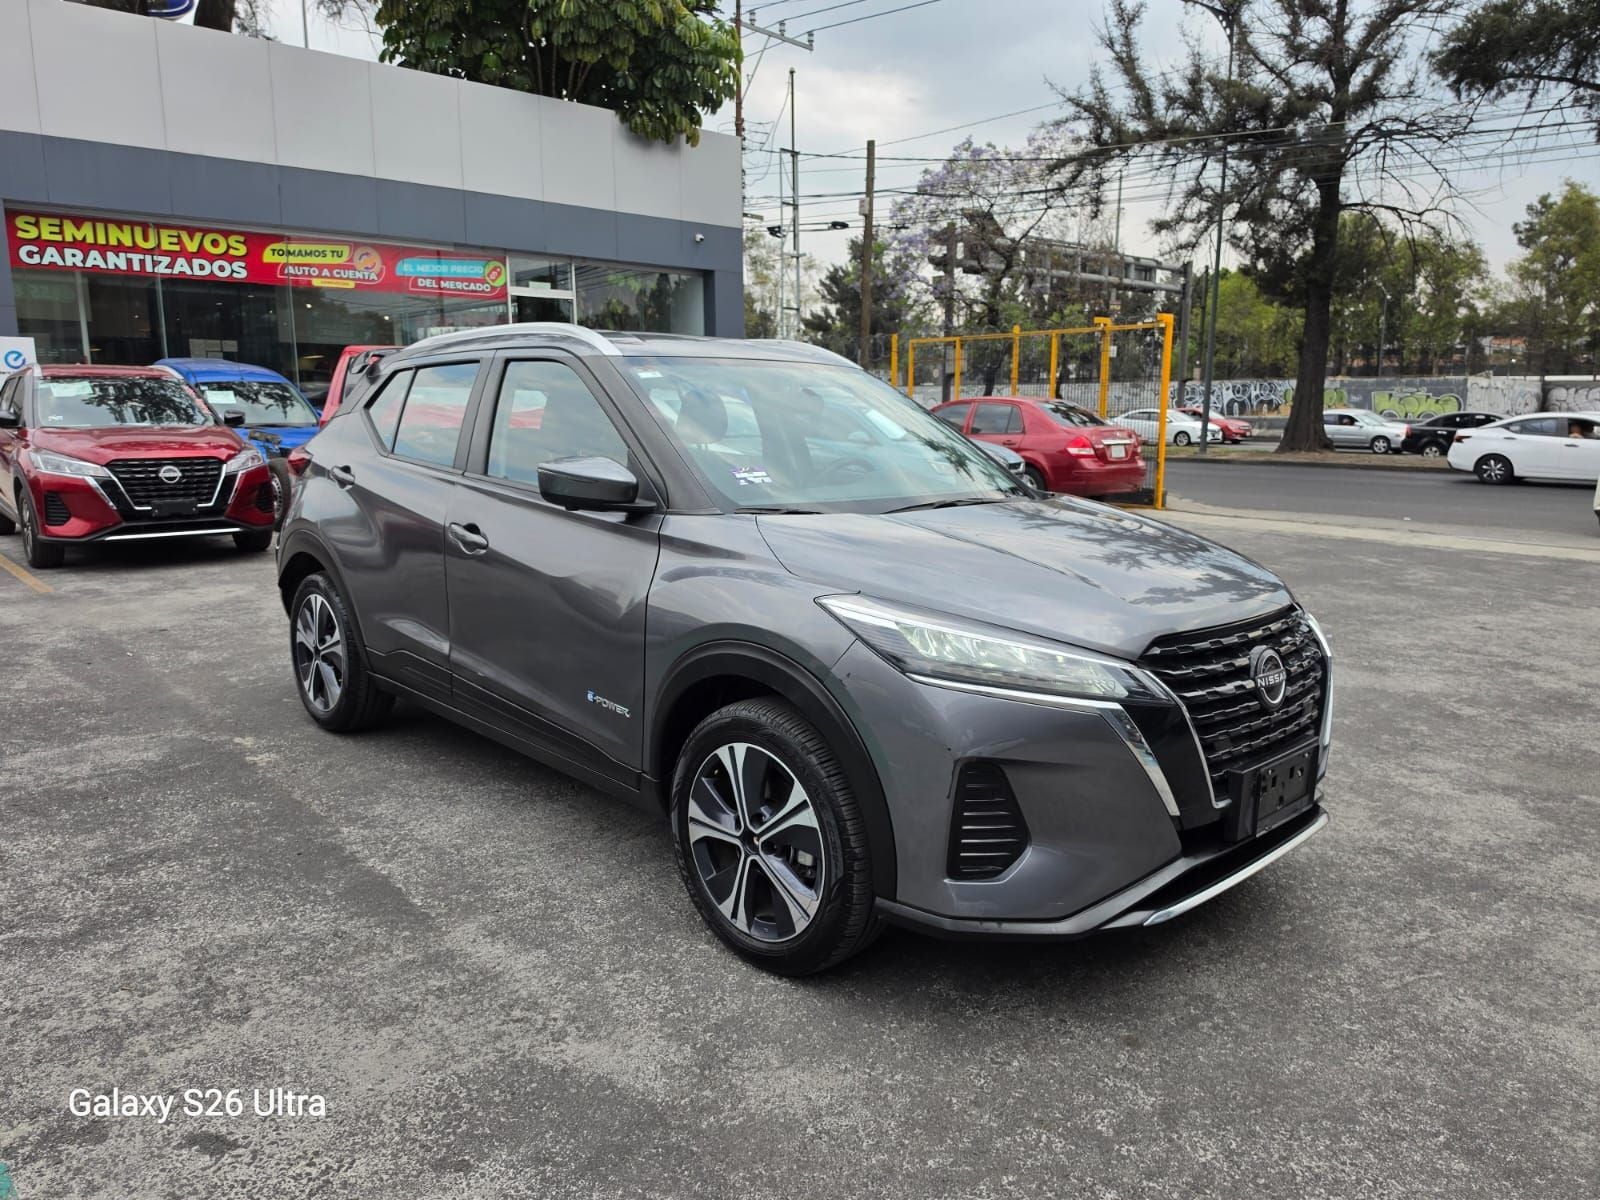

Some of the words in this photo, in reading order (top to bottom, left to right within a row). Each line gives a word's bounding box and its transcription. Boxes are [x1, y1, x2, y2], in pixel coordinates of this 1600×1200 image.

[15, 215, 248, 257] SEMINUEVOS
[270, 248, 327, 258] TOMAMOS
[330, 249, 344, 258] TU
[18, 245, 248, 279] GARANTIZADOS
[284, 265, 319, 276] AUTO
[322, 268, 331, 277] A
[333, 268, 378, 281] CUENTA
[417, 277, 439, 288] DEL
[440, 280, 491, 292] MERCADO
